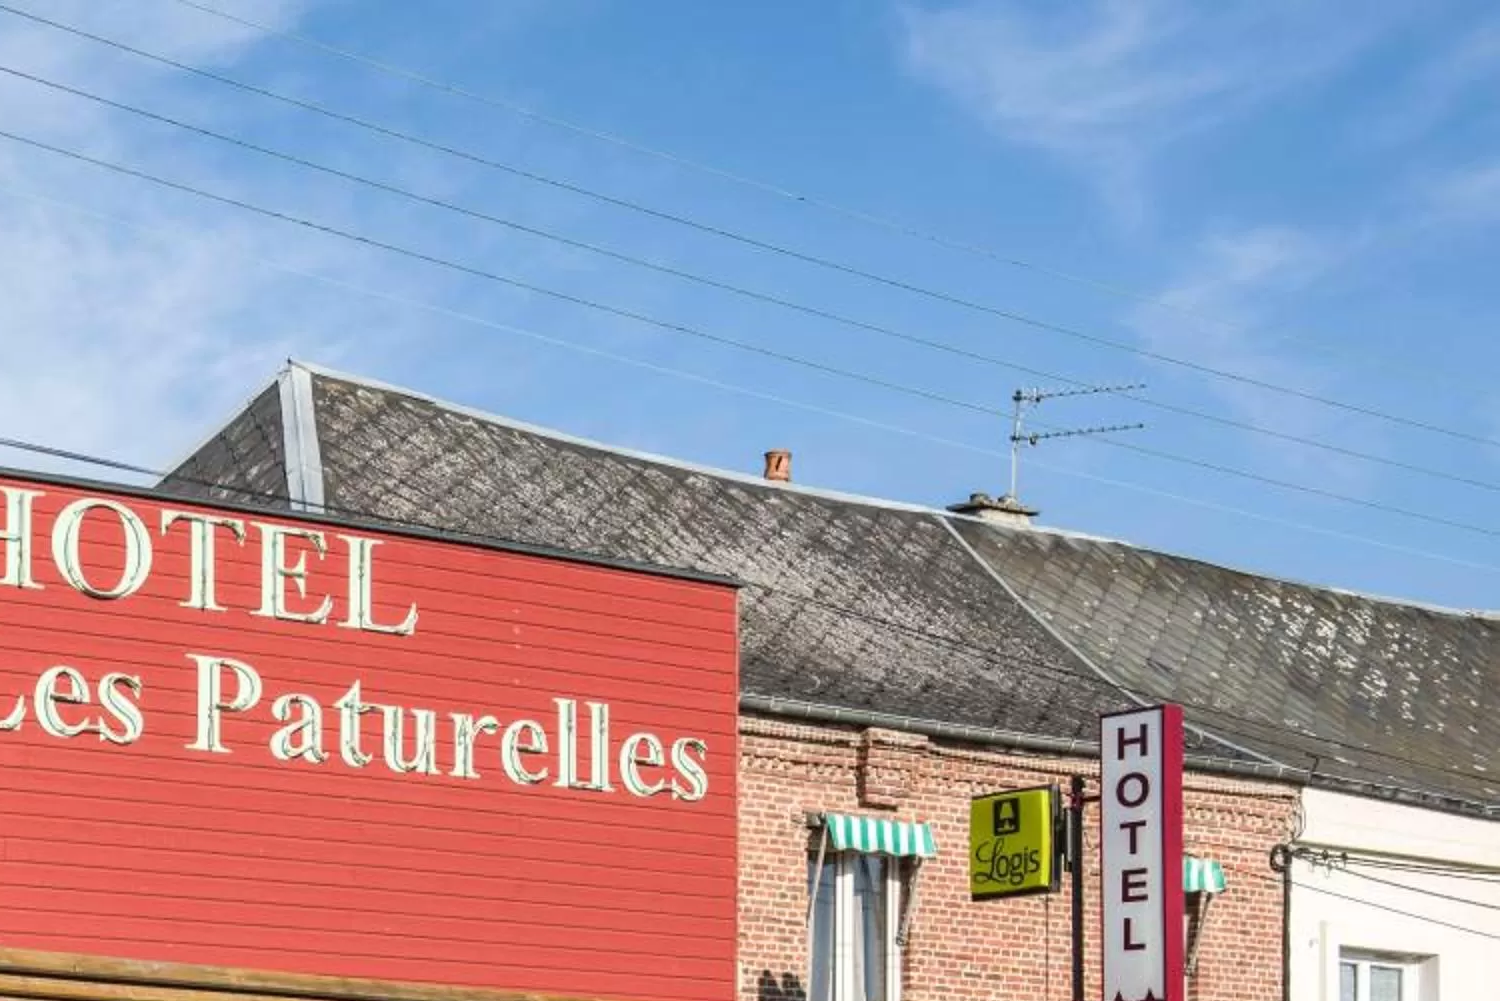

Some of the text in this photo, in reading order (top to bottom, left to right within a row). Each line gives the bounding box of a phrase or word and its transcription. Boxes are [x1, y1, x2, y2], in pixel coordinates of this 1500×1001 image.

[184, 653, 709, 802] Paturelles
[974, 838, 1040, 886] Logis
[1115, 723, 1151, 952] HOTEL
